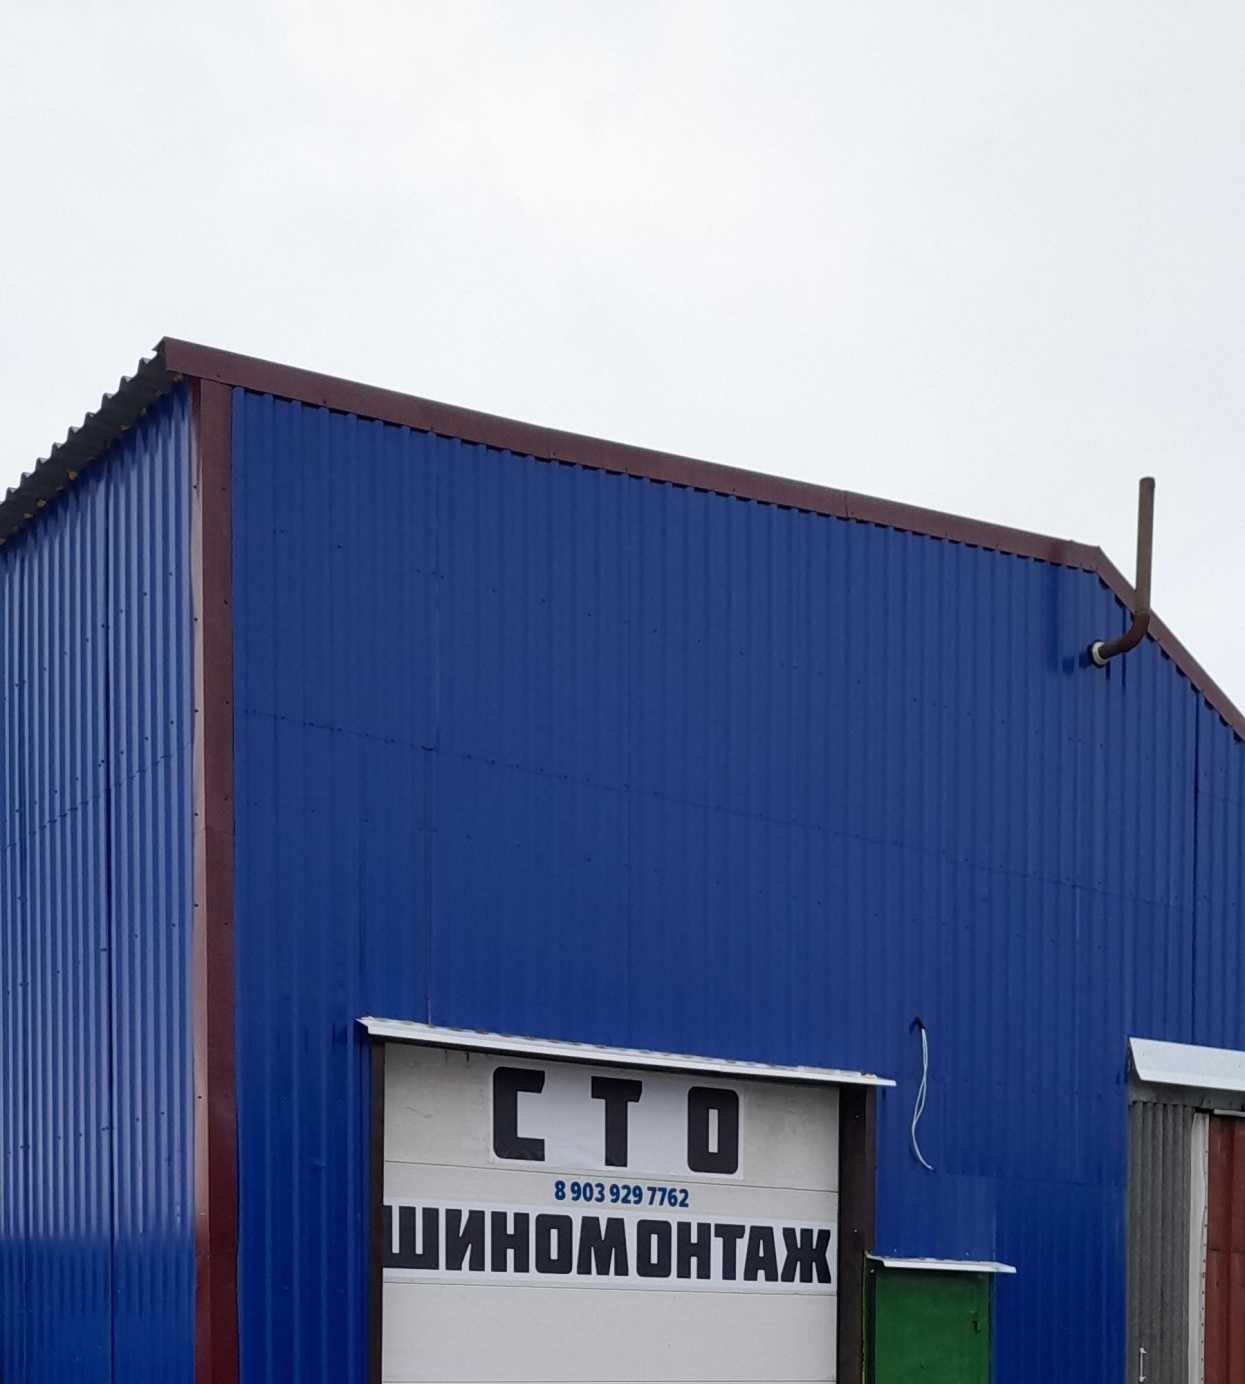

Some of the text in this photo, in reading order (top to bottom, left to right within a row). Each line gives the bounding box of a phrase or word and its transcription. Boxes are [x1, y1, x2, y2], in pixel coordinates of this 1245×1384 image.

[492, 1065, 740, 1175] СТО
[554, 1180, 689, 1208] 8 903 929 7762
[383, 1204, 831, 1284] ШИНОМОНТАЖ
